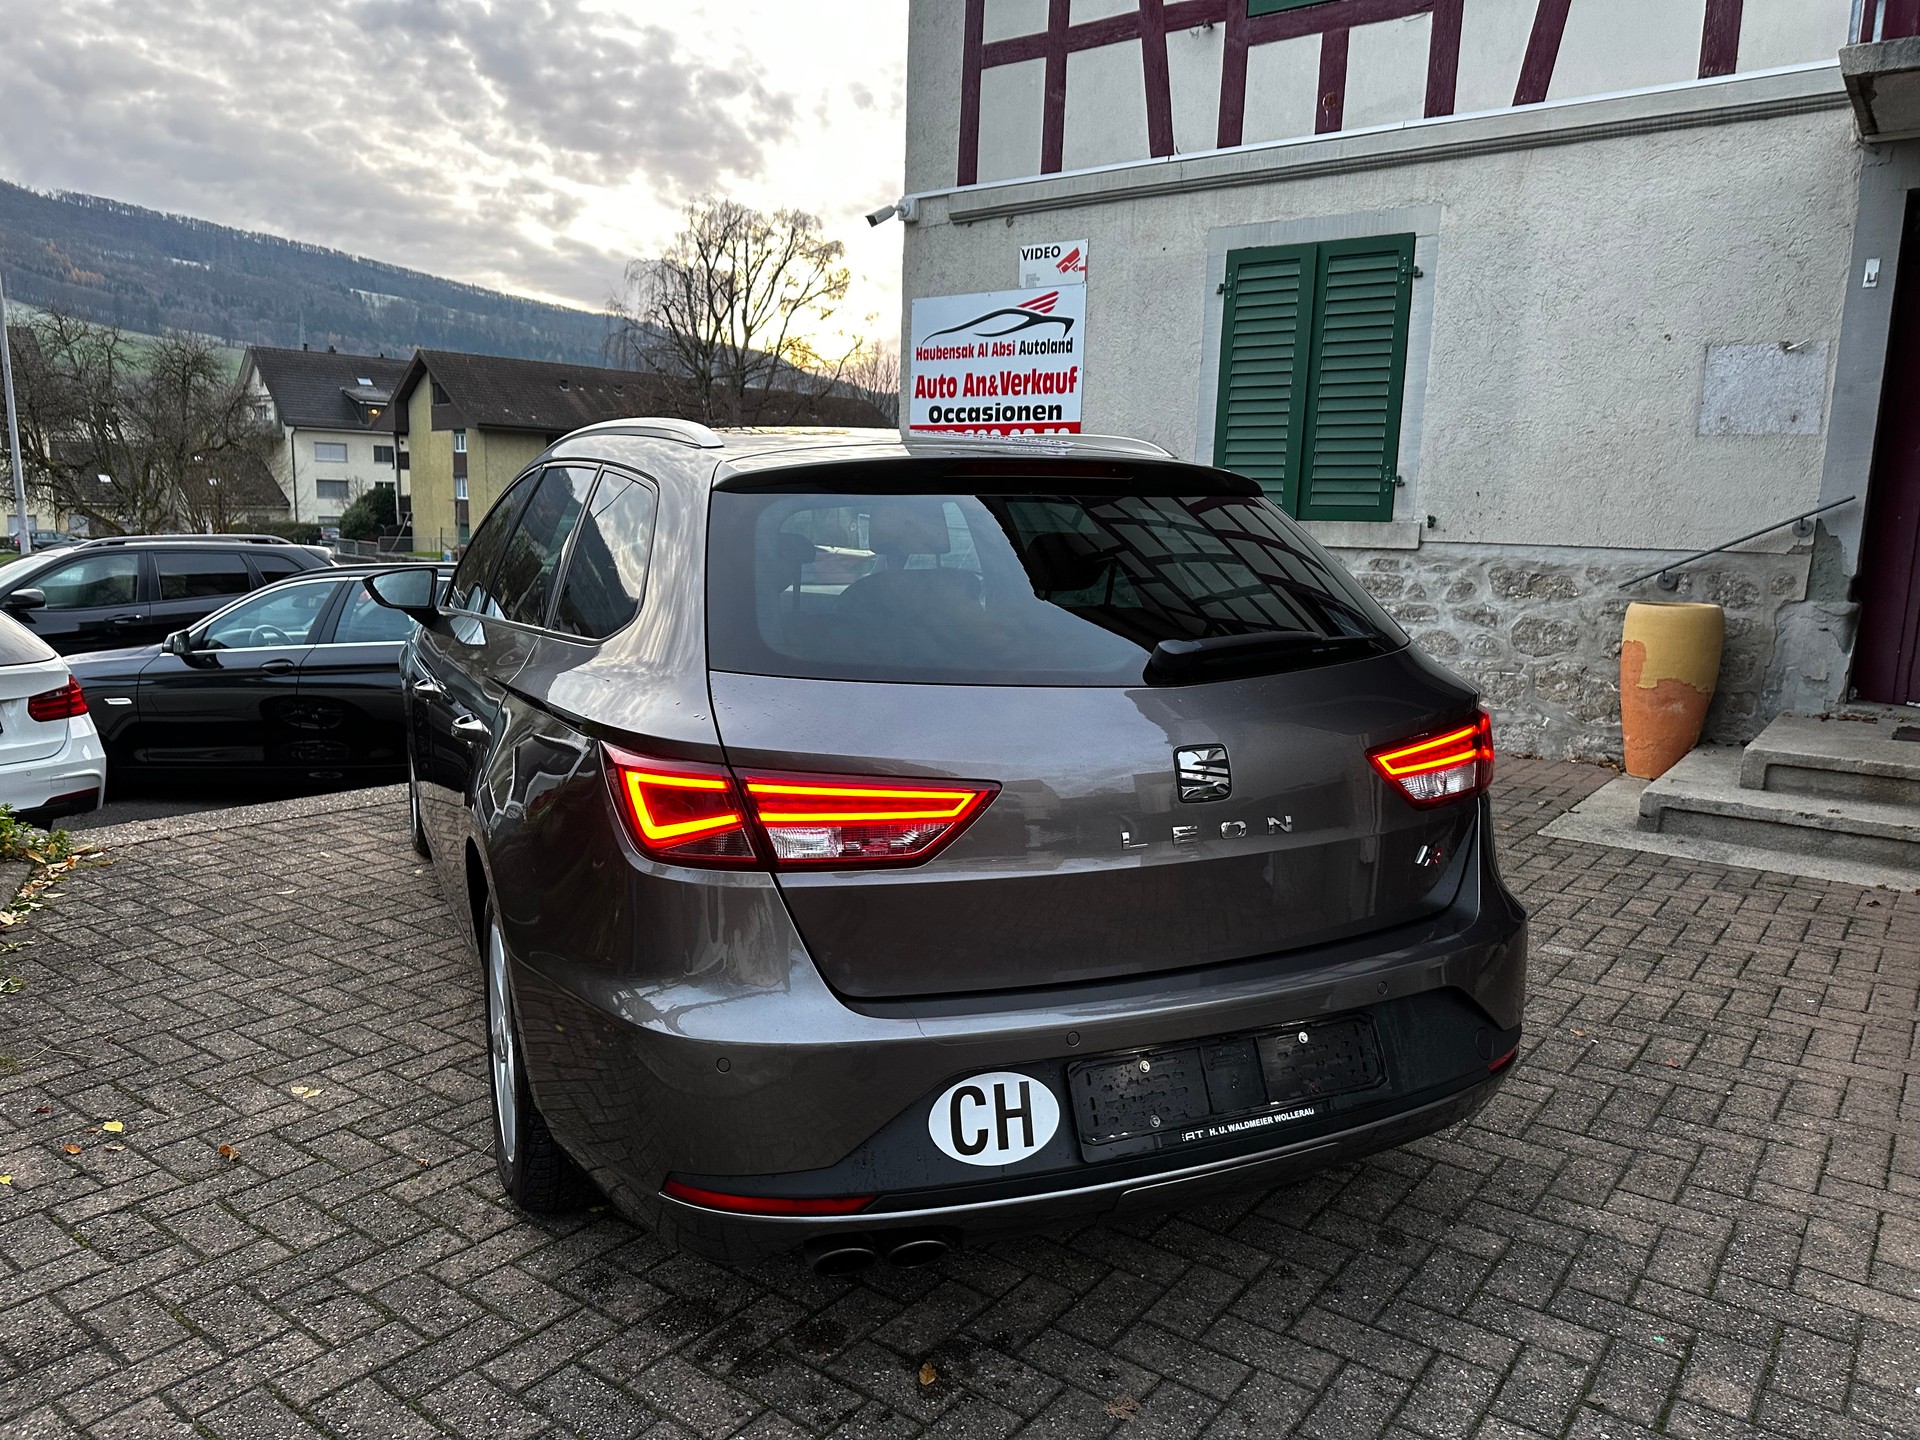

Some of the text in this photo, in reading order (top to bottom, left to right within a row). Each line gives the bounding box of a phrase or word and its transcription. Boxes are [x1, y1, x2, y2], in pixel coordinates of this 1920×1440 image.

[1021, 245, 1061, 261] VIDEO
[916, 337, 1073, 361] Haubensak Al Absi Autoland
[915, 365, 1078, 399] Auto An&Verkauf
[928, 403, 1063, 423] Occasionen
[1121, 815, 1293, 850] LEON
[950, 1080, 1035, 1156] CH
[1227, 1116, 1274, 1133] WALDMEIER
[1273, 1107, 1315, 1123] WOLLERAU
